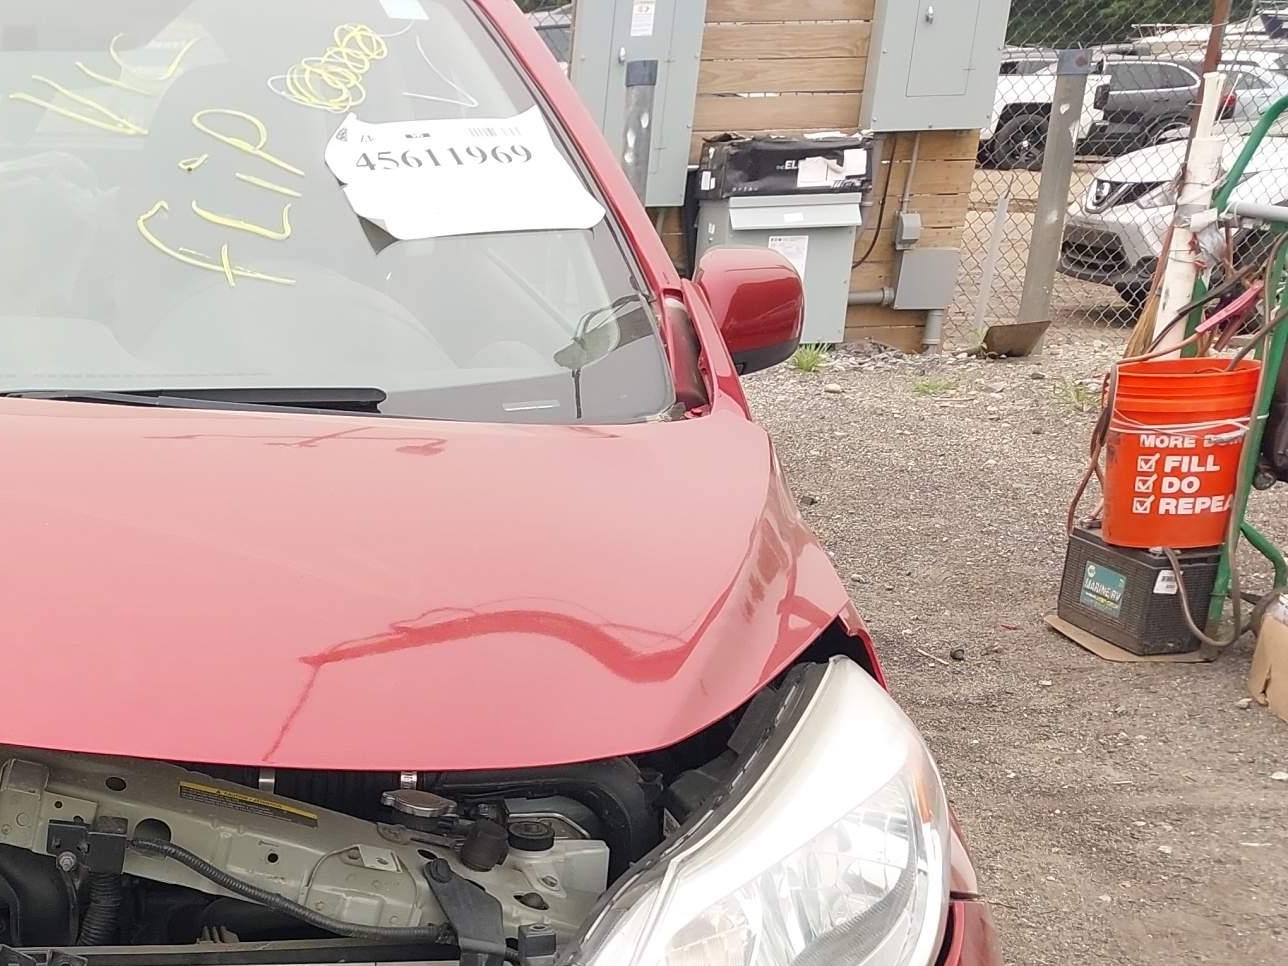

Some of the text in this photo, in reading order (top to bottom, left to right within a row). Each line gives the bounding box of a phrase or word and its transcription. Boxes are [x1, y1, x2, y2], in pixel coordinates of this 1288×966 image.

[355, 144, 532, 171] 45611969
[1139, 434, 1196, 449] MORE
[1163, 454, 1221, 473] FILL
[1160, 476, 1201, 494] DO
